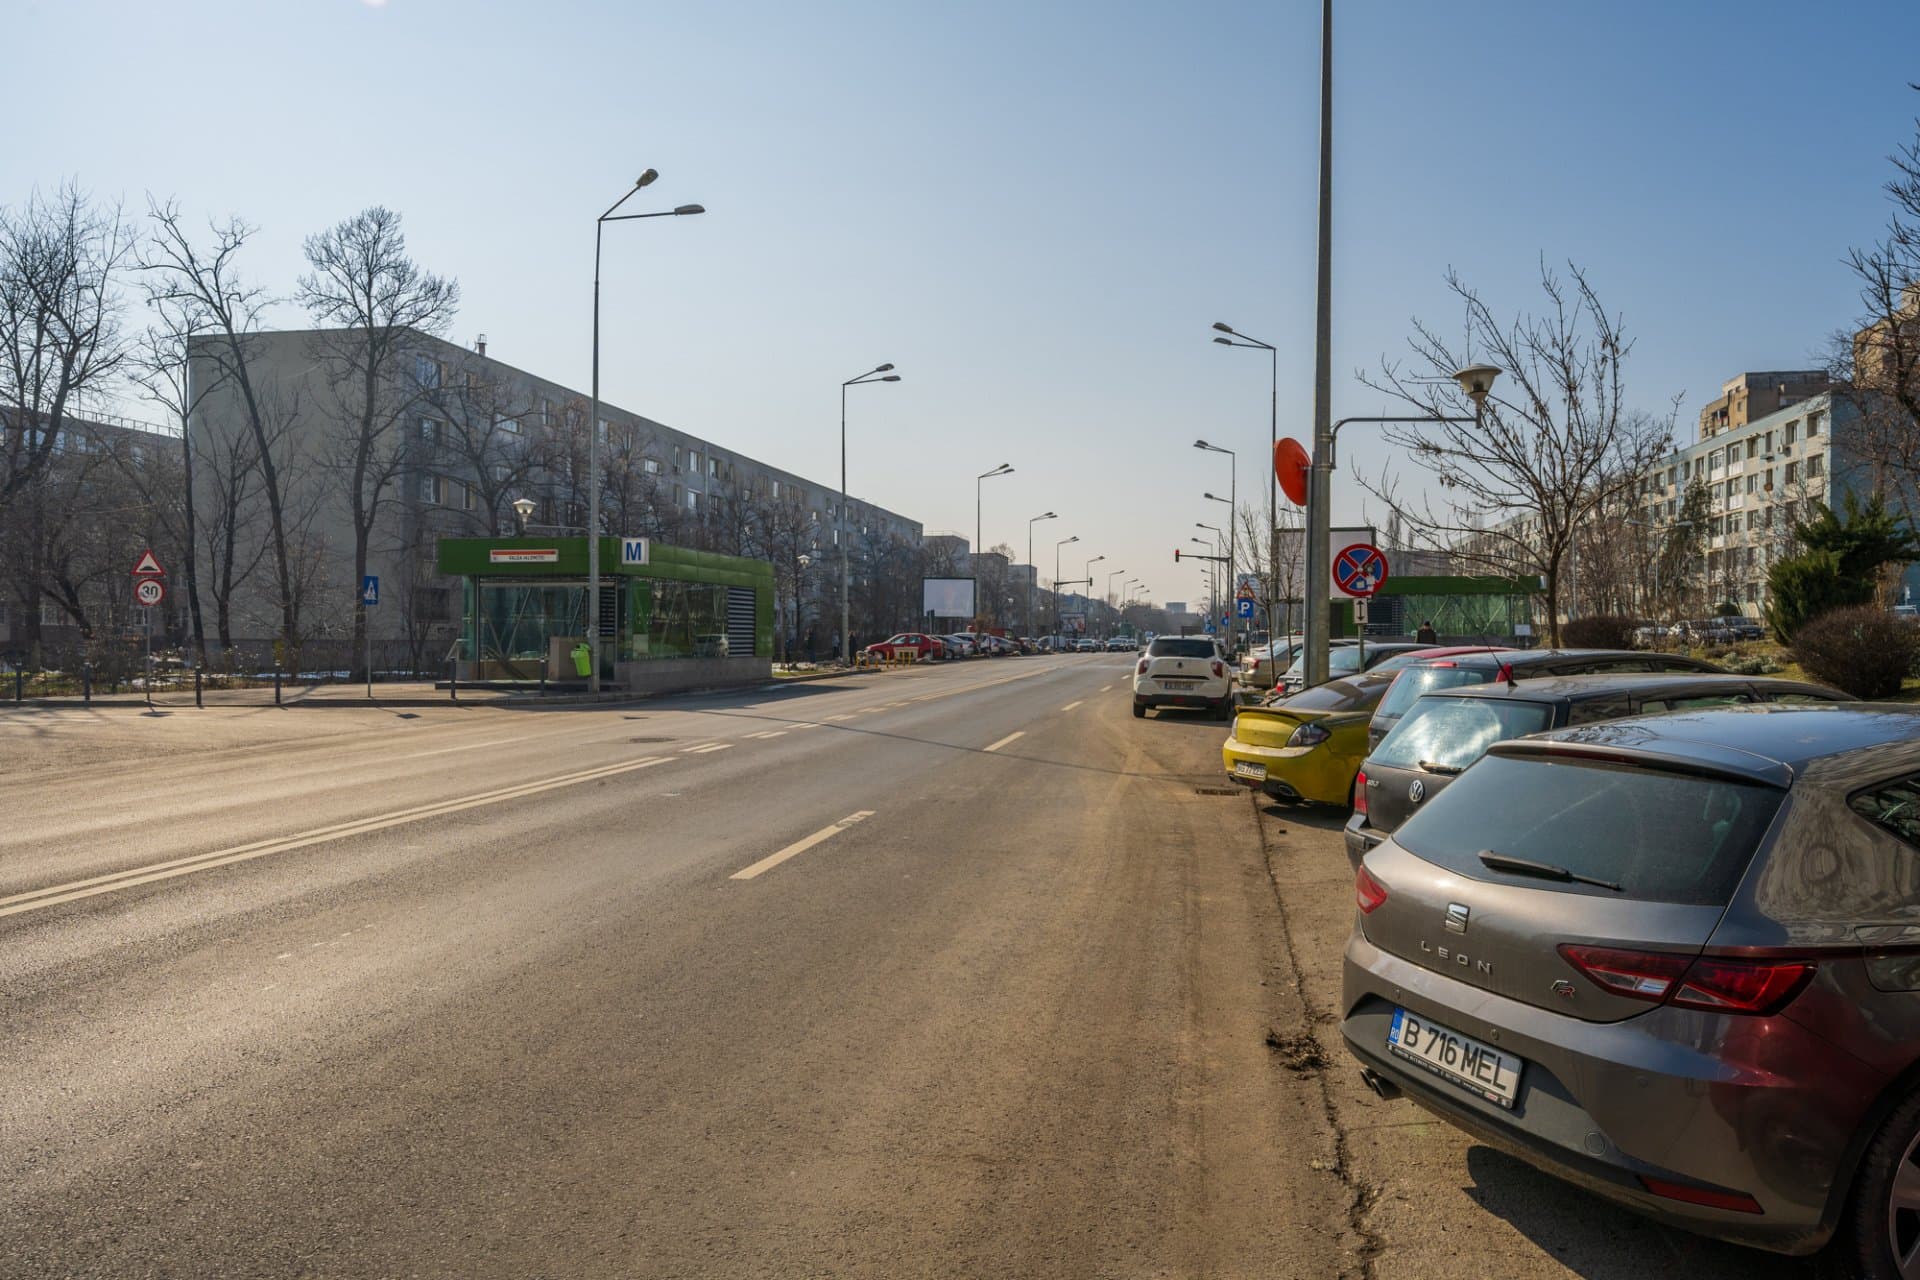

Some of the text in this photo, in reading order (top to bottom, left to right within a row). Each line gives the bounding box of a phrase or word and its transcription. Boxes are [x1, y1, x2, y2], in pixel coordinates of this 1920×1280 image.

[626, 542, 641, 560] M
[142, 585, 158, 598] 30
[1241, 602, 1250, 614] P
[1421, 941, 1491, 974] LEON
[1404, 1018, 1420, 1047] B
[1424, 1027, 1458, 1066] 716
[1460, 1042, 1506, 1091] MEL
